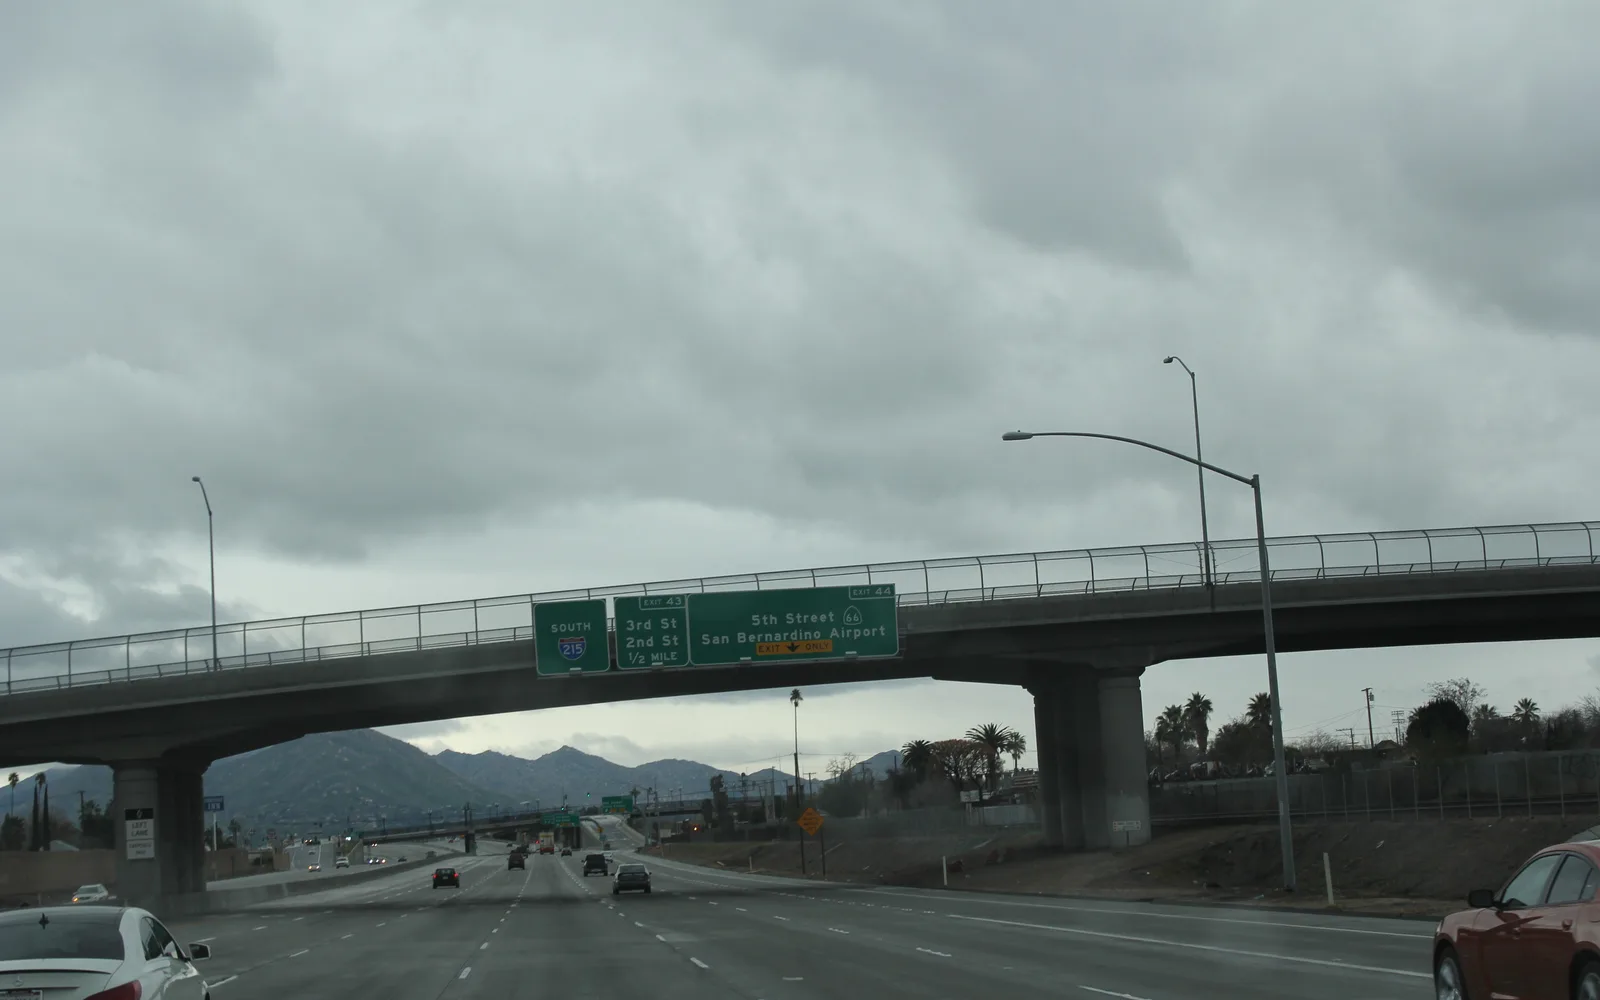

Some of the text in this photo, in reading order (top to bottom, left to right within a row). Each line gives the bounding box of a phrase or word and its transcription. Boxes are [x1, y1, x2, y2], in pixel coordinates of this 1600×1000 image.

[852, 586, 891, 596] EXIT 44
[644, 597, 682, 606] EXIT 43
[751, 611, 835, 626] 5th Street
[846, 614, 860, 622] 66
[551, 622, 591, 633] SOUTH
[626, 618, 677, 631] 3rd St
[701, 625, 886, 645] San Bernardino Airport
[626, 635, 679, 648] 2nd St
[563, 644, 583, 655] 215
[758, 642, 829, 653] EXIT ONLY
[629, 651, 678, 665] 1/2 MILE
